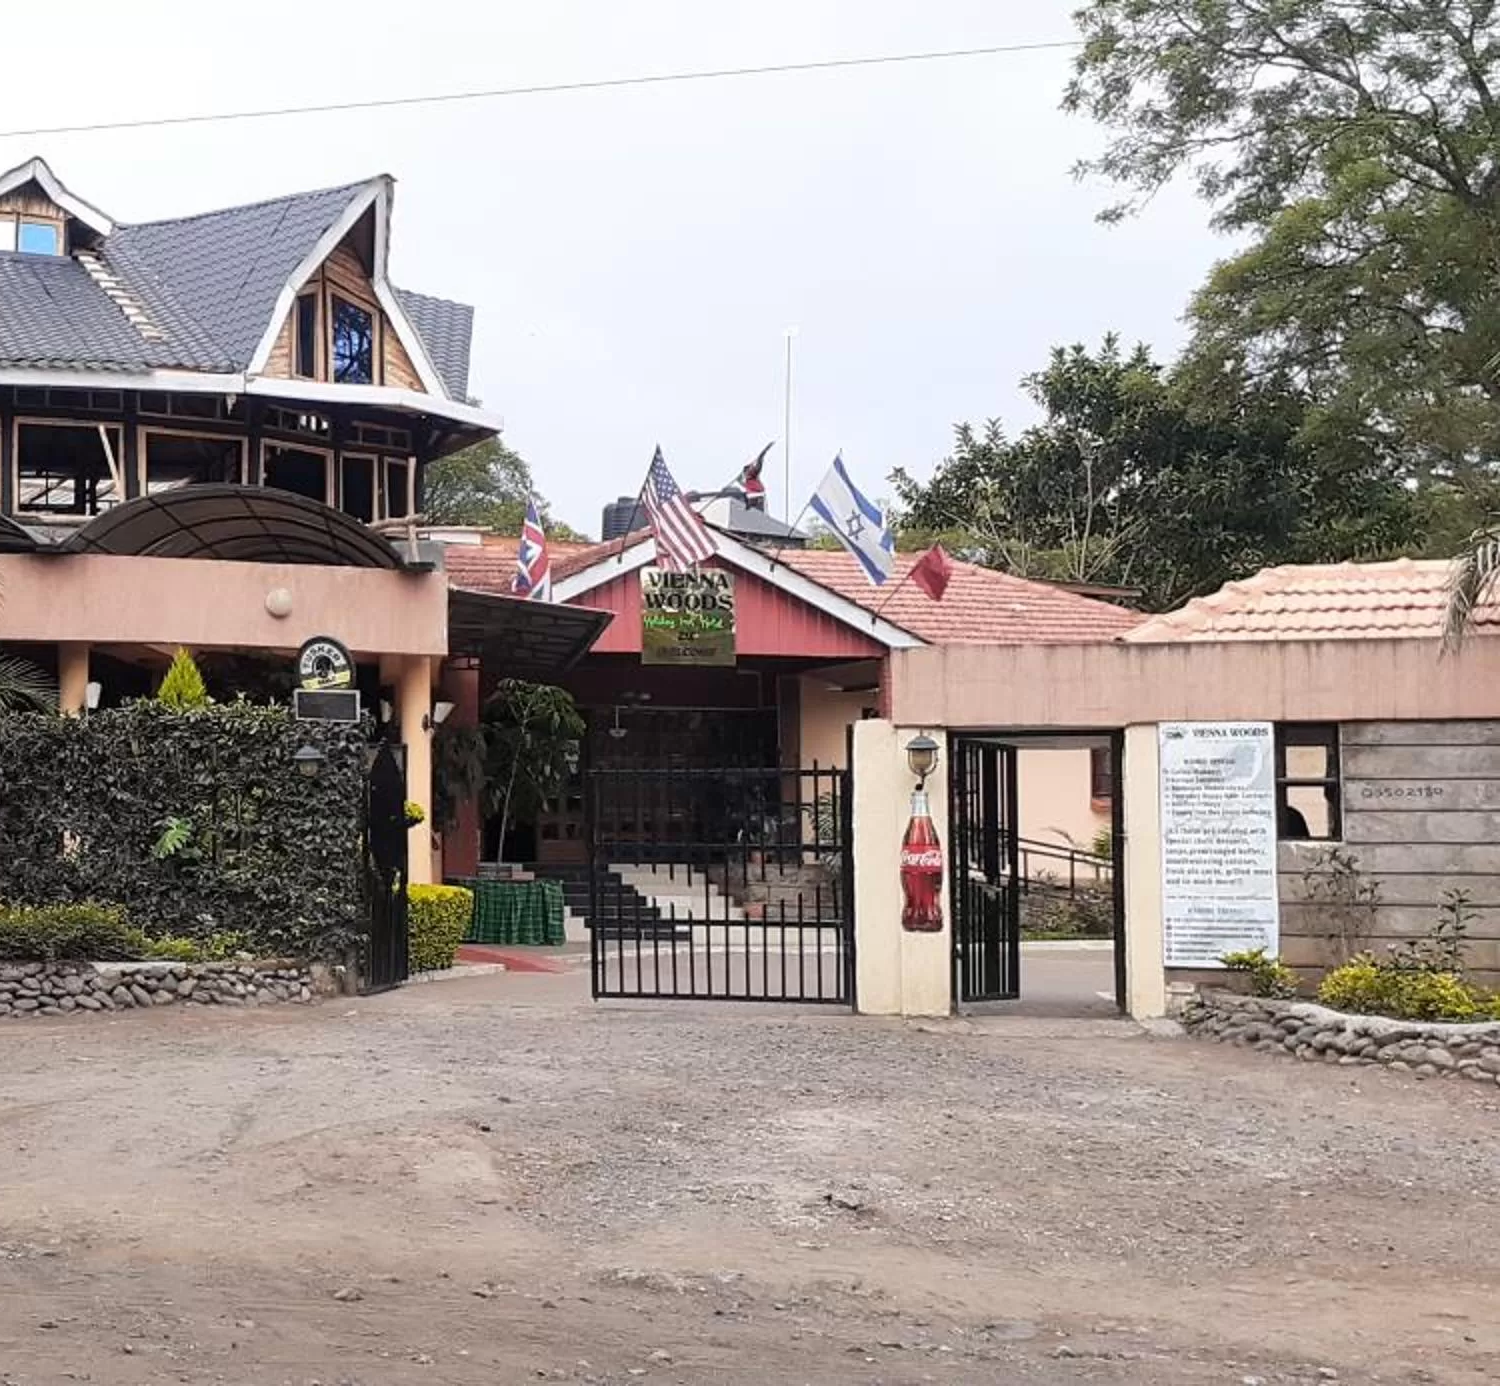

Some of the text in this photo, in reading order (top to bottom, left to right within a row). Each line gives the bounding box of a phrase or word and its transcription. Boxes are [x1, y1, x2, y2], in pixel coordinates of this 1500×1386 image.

[648, 572, 728, 588] VIENNA
[644, 593, 733, 612] WOODS
[301, 645, 342, 669] TUSKER
[1192, 727, 1269, 737] VIENNA WOODS
